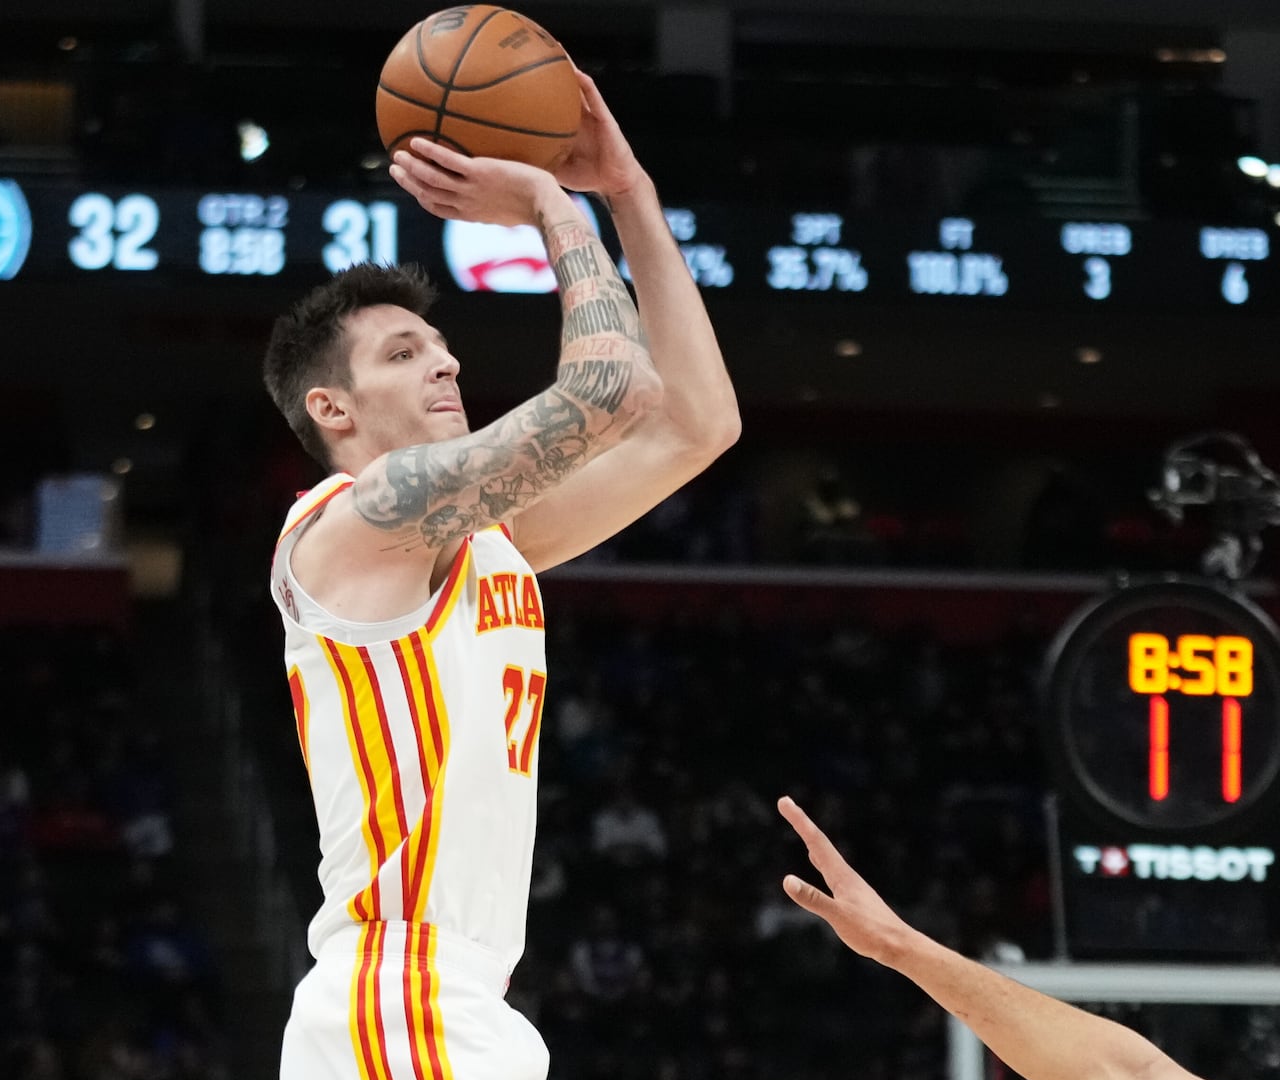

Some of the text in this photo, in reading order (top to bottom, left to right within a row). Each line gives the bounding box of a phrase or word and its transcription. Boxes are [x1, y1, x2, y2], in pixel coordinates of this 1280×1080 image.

[69, 193, 160, 271] 32
[322, 199, 398, 274] 31
[475, 571, 545, 636] ATLA
[1128, 632, 1254, 697] 8:58
[502, 663, 547, 778] 27
[1149, 694, 1243, 803] 11
